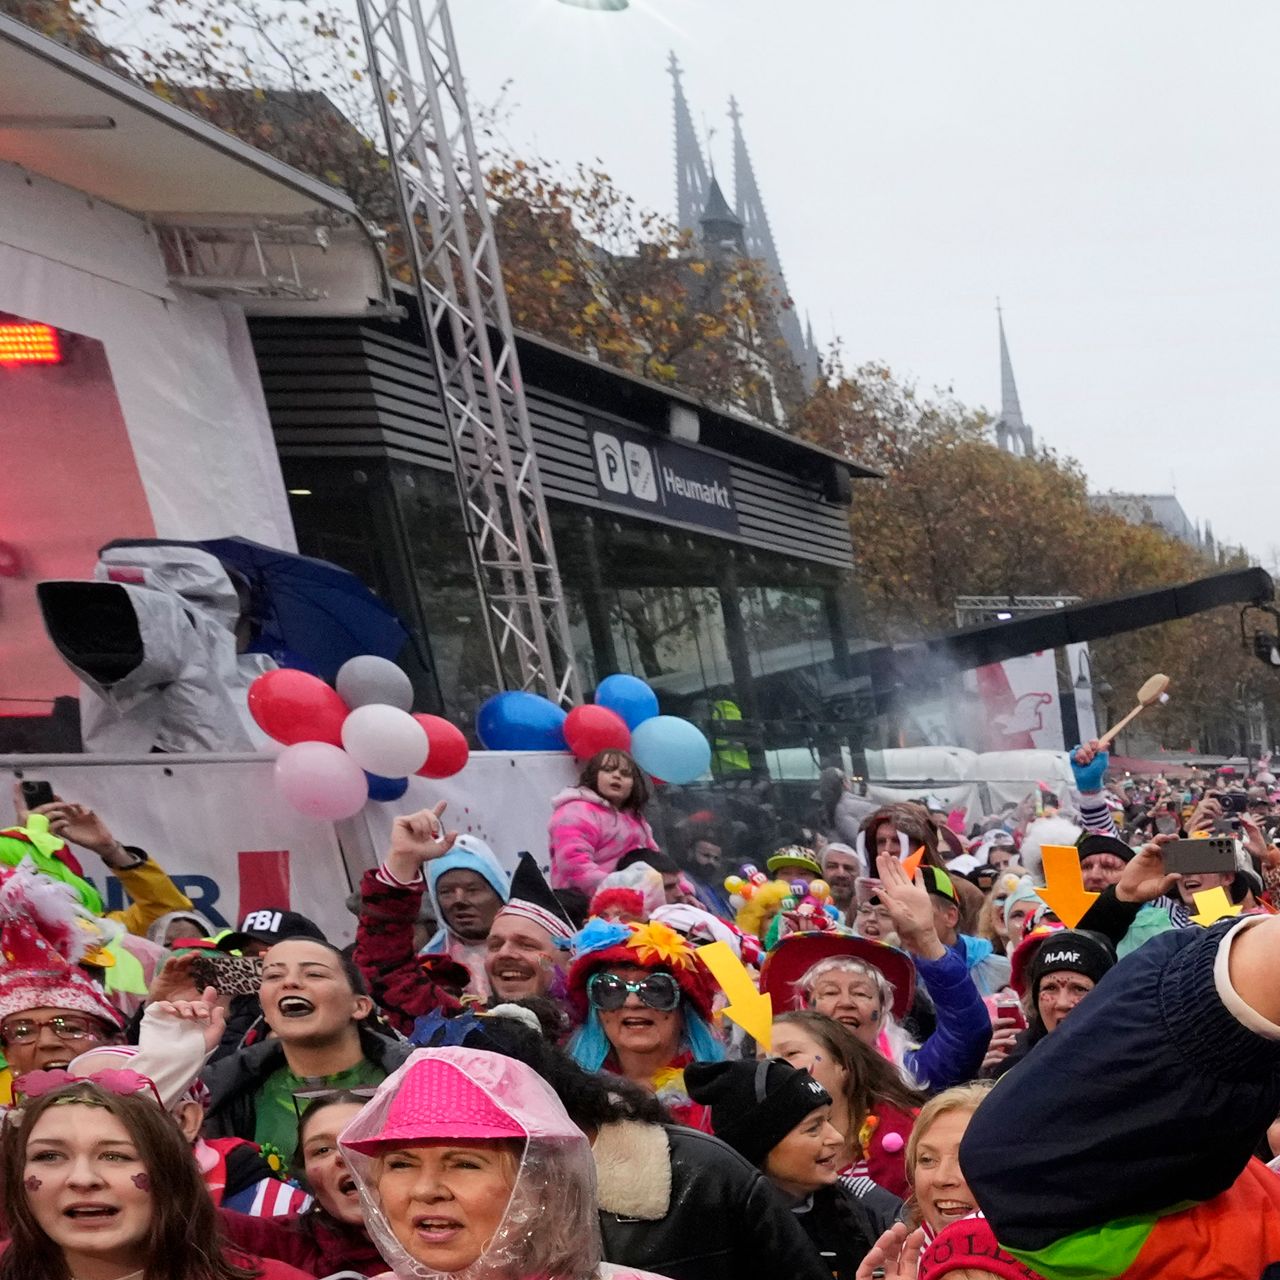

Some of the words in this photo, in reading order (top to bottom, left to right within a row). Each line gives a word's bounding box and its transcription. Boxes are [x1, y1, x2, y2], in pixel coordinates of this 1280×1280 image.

[662, 466, 731, 509] Heumarkt
[242, 910, 284, 933] FBI
[1044, 951, 1081, 964] ALAAF
